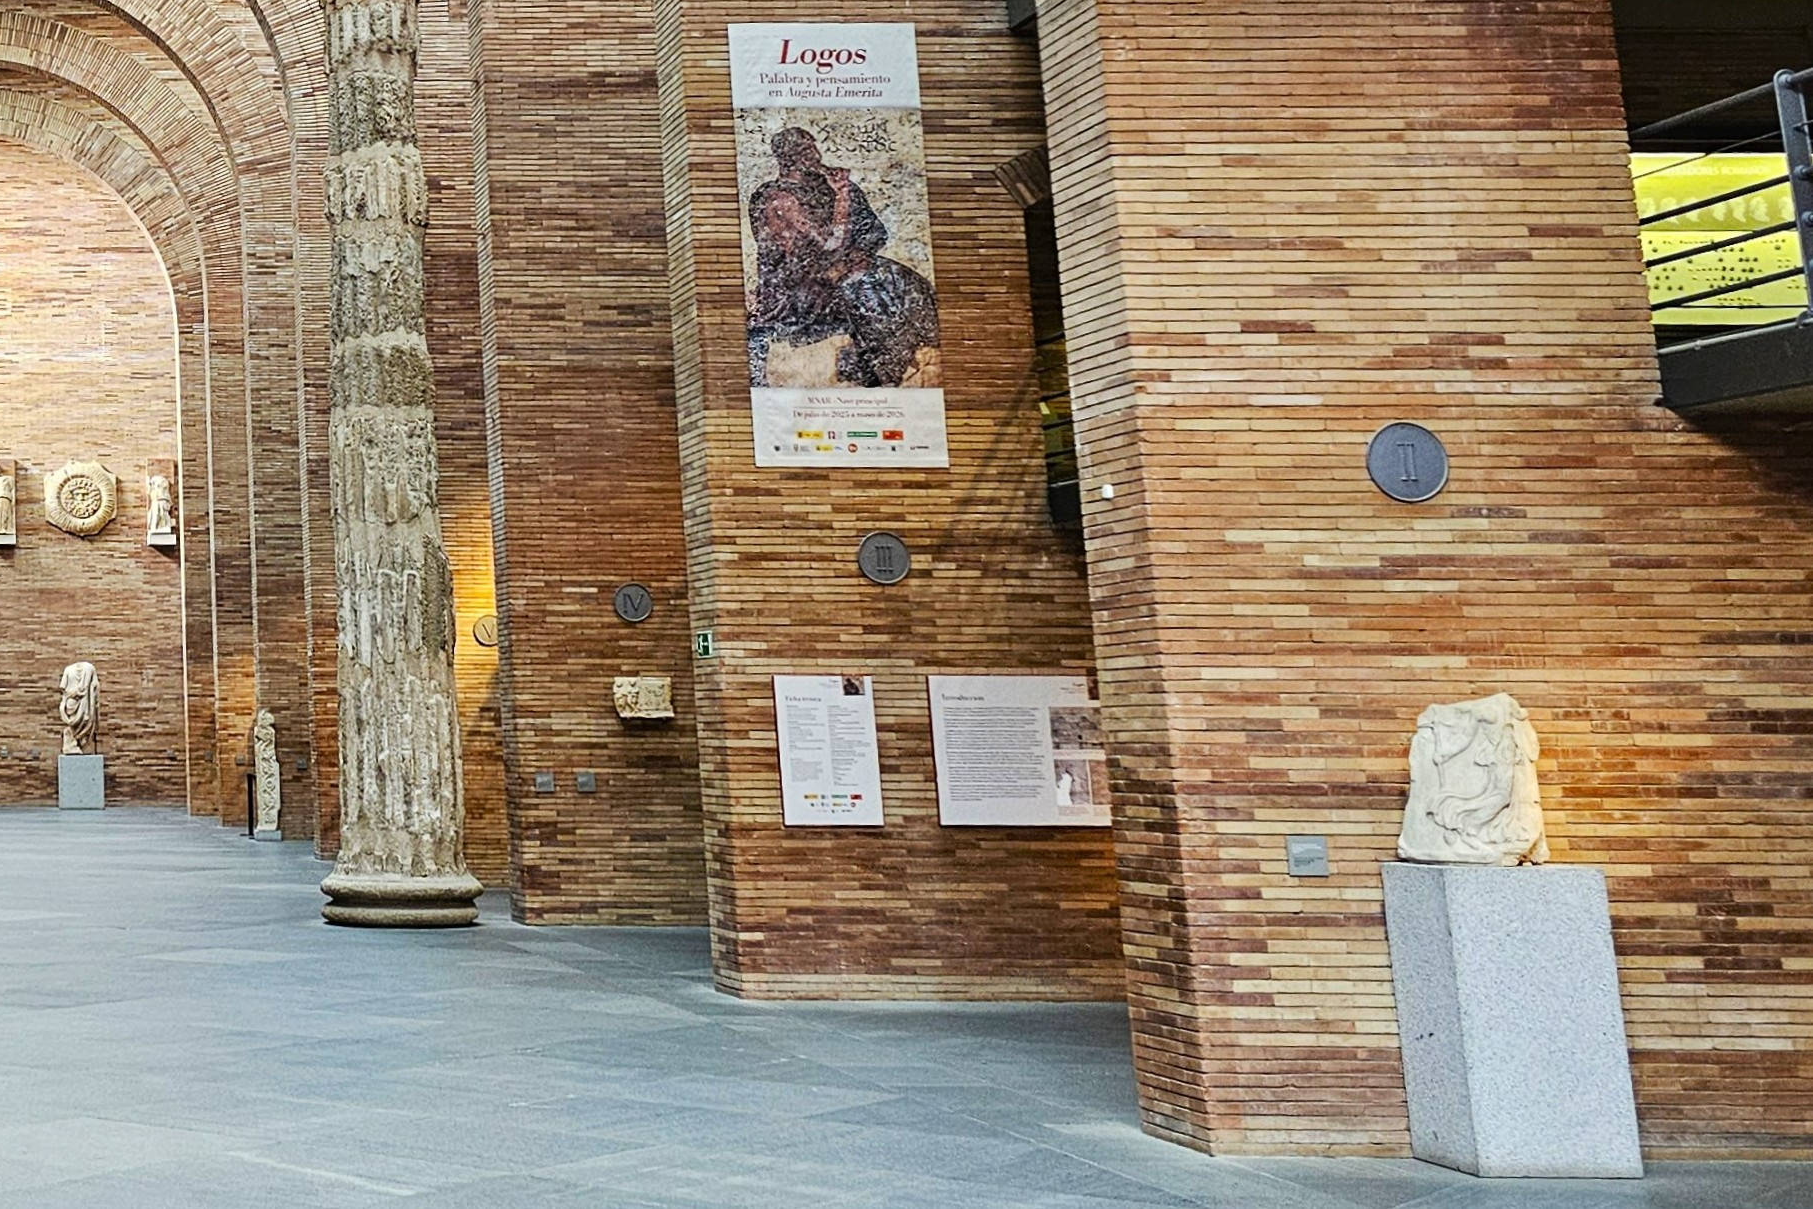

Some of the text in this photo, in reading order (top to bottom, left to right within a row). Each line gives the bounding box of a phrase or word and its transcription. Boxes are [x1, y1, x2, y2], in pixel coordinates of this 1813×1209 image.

[778, 38, 867, 75] Logos
[759, 72, 891, 90] Palabra y pensamiento
[768, 86, 883, 100] en Augusta Emerita
[1395, 442, 1419, 483] II
[874, 543, 895, 574] III
[622, 592, 644, 614] IV
